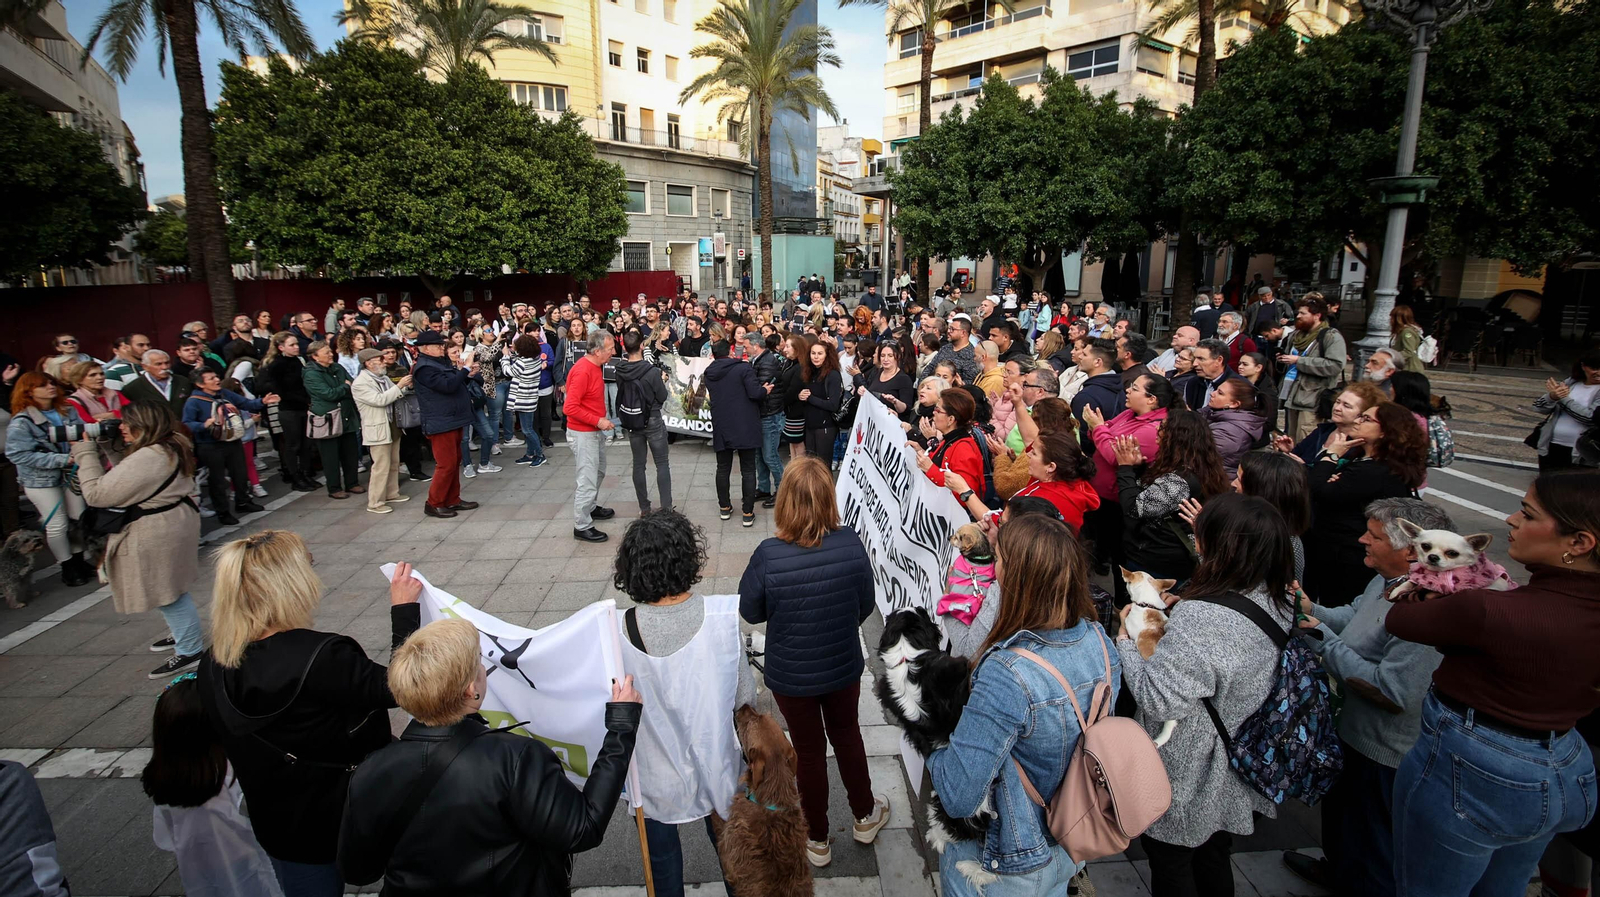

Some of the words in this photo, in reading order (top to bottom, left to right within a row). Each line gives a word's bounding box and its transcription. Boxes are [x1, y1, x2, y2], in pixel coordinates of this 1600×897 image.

[864, 416, 877, 454] NO
[873, 430, 884, 468] AL
[848, 458, 857, 480] EL
[855, 466, 879, 513] COARDE
[871, 499, 890, 542] MATA
